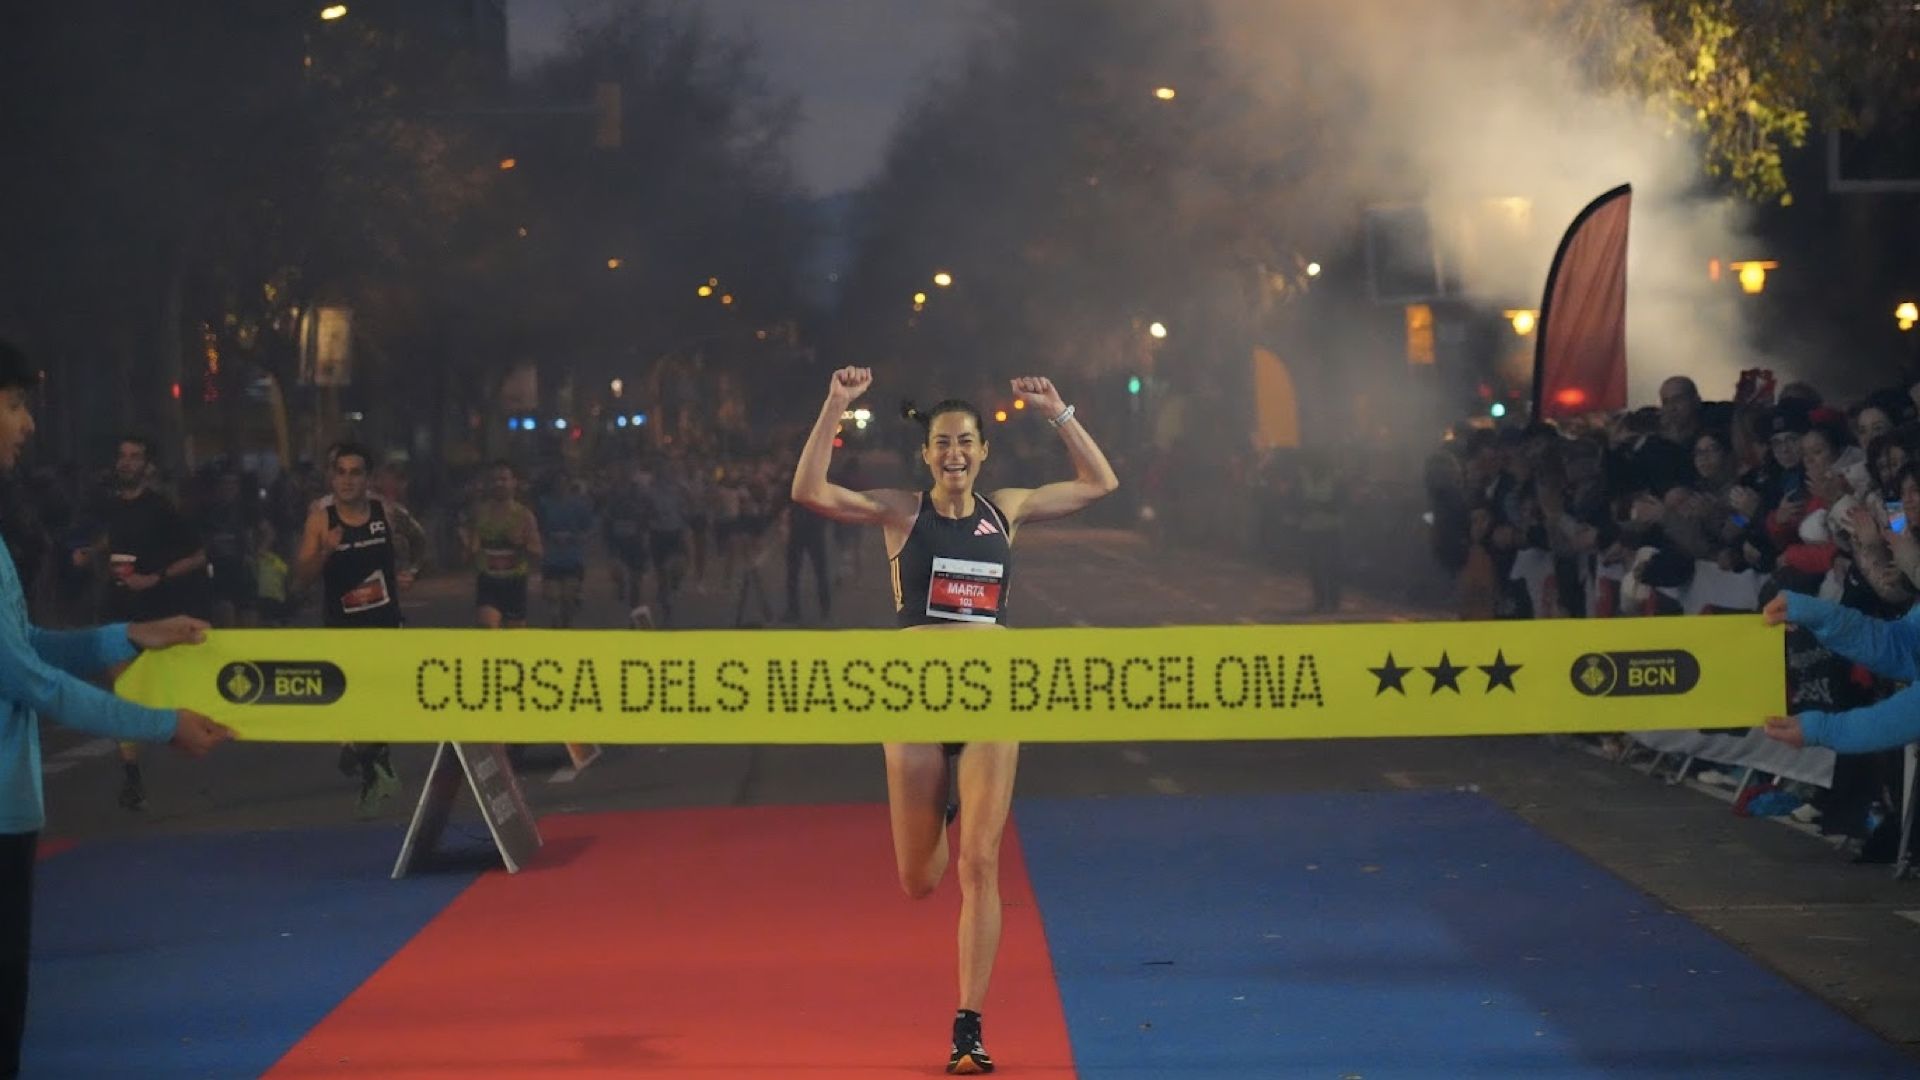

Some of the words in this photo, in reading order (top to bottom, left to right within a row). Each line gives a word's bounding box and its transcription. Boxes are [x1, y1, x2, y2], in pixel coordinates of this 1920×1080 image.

[947, 582, 985, 598] MARTA
[275, 677, 323, 696] BCN
[416, 658, 603, 712] CURSA
[620, 659, 750, 713] DELS
[767, 659, 993, 713] NASSOS
[1009, 654, 1325, 711] BARCELONA
[1628, 666, 1677, 687] BCN
